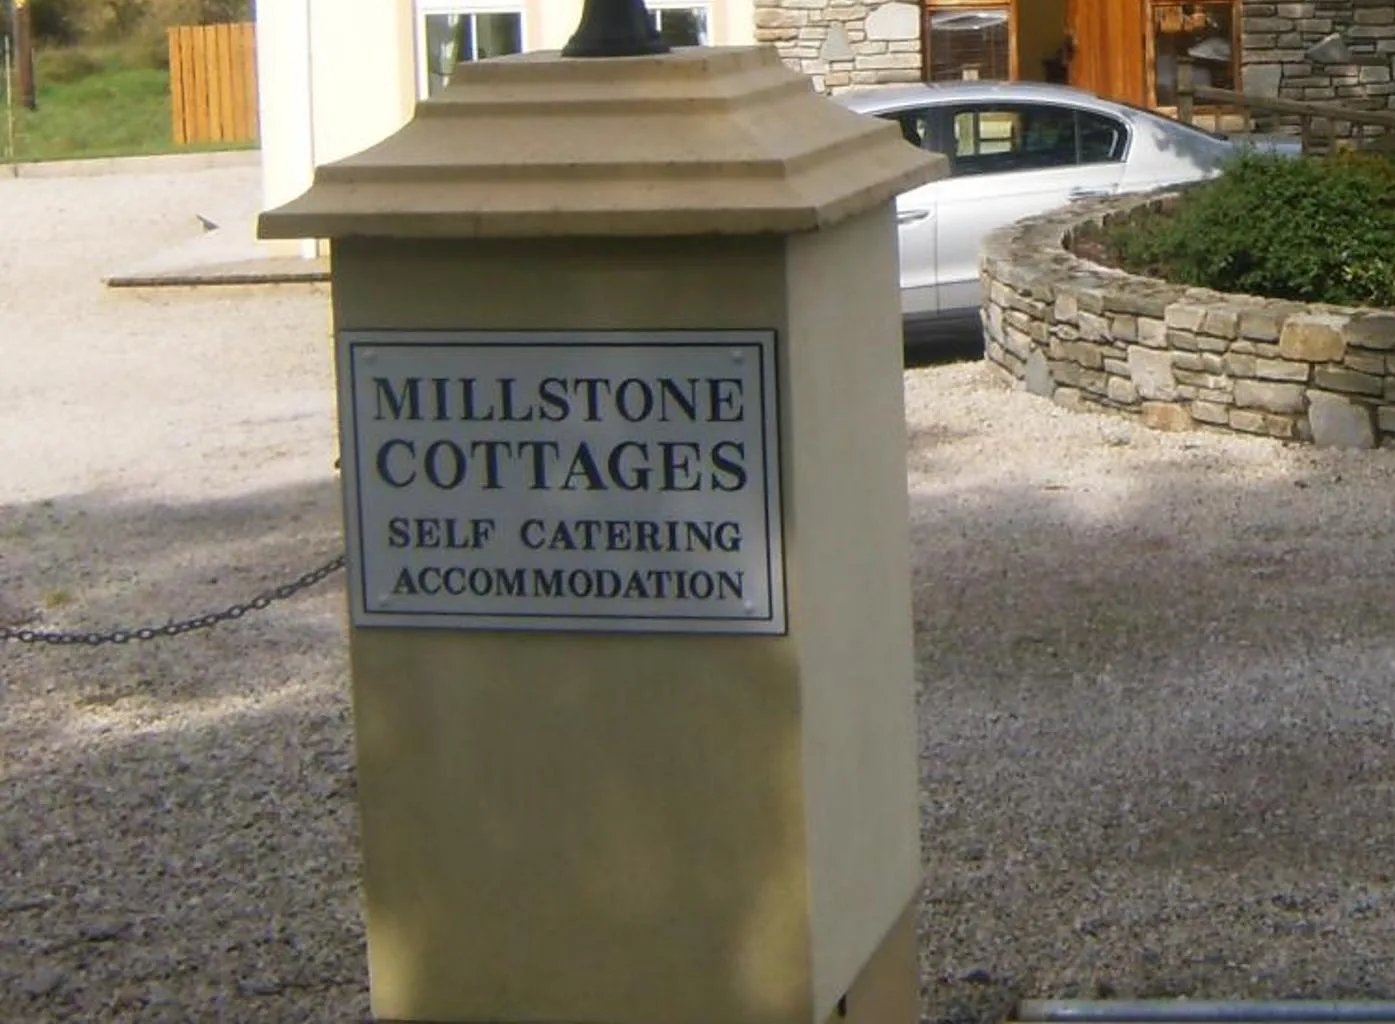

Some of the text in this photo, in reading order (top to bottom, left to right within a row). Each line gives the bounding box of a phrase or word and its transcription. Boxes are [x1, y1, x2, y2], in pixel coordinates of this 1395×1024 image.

[373, 376, 744, 422] MILLSTONE
[375, 439, 748, 492] COTTAGES
[388, 517, 743, 553] SELF CATERING
[393, 566, 744, 600] ACCOMMODATION
